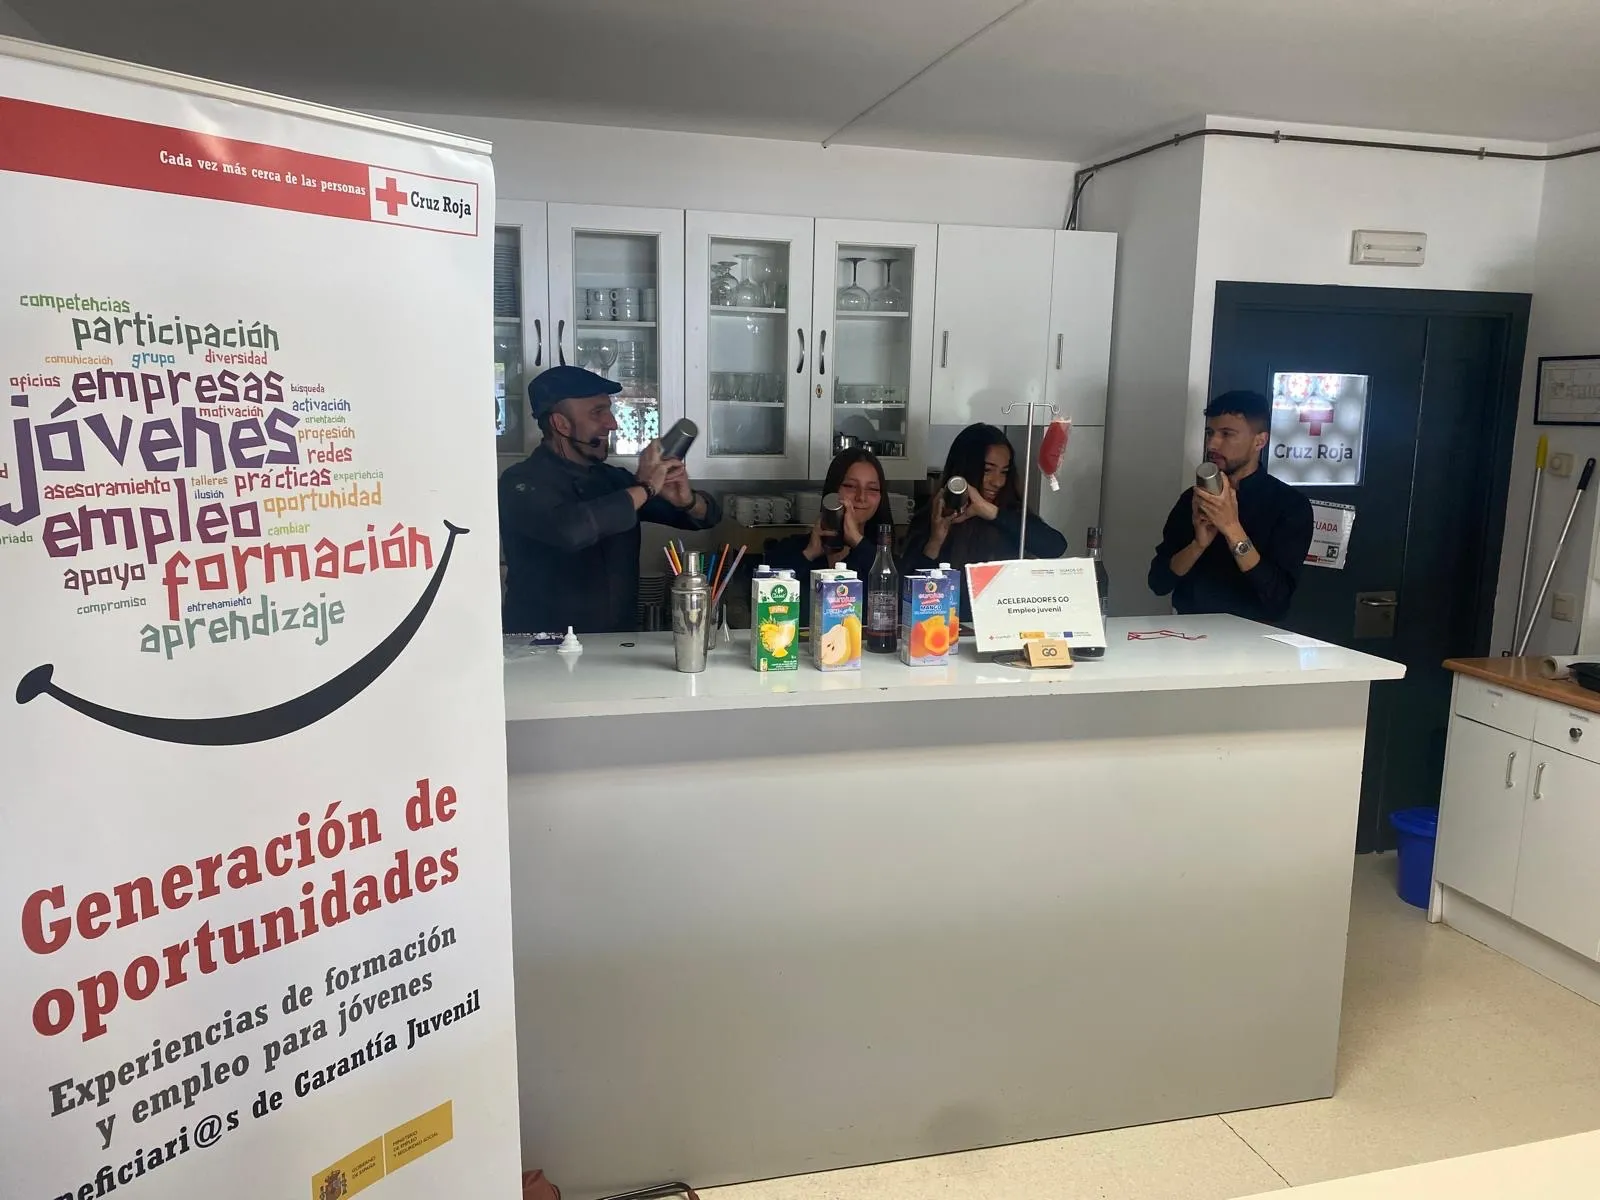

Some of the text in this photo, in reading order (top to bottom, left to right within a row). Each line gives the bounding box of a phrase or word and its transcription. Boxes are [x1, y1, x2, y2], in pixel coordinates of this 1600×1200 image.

[160, 150, 366, 196] Cada vez más cerca de las personas
[410, 191, 471, 219] Cruz Roja
[20, 294, 130, 313] competencias
[72, 311, 279, 355] participación
[45, 354, 113, 366] comunicación
[131, 351, 175, 368] grupo
[205, 349, 267, 365] diversidad
[10, 373, 60, 392] oficios
[72, 368, 284, 414] empresas
[291, 383, 325, 395] búsqueda
[199, 404, 264, 418] motivación
[292, 398, 351, 412] activación
[305, 415, 346, 424] orientación
[298, 426, 355, 444] profesión
[0, 395, 300, 526] jóvenes
[307, 442, 352, 464] redes
[1274, 443, 1353, 462] Cruz Roja
[191, 474, 229, 487] talleres
[234, 465, 331, 497] prácticas
[333, 468, 384, 482] experiencia
[44, 476, 171, 500] asesoramiento
[194, 488, 224, 500] ilusión
[264, 482, 382, 516] oportunidad
[42, 477, 262, 564] empleo
[267, 522, 311, 536] cambiar
[63, 563, 146, 595] apoyo
[162, 522, 434, 621] formación
[77, 596, 147, 615] compromiso
[187, 596, 252, 613] entrenamiento
[997, 595, 1070, 605] ACELERADORES GO
[1008, 605, 1061, 615] Empleo juvenil
[141, 592, 346, 660] aprendizaje
[1042, 648, 1058, 657] GO
[20, 777, 458, 955] Generación de
[32, 846, 460, 1042] oportunidades
[48, 924, 457, 1117] Experiencias de formación
[95, 969, 433, 1151] y empleo para jóvenes
[252, 1090, 283, 1120] de
[294, 1032, 398, 1098] Garantía
[407, 989, 481, 1049] Juvenil
